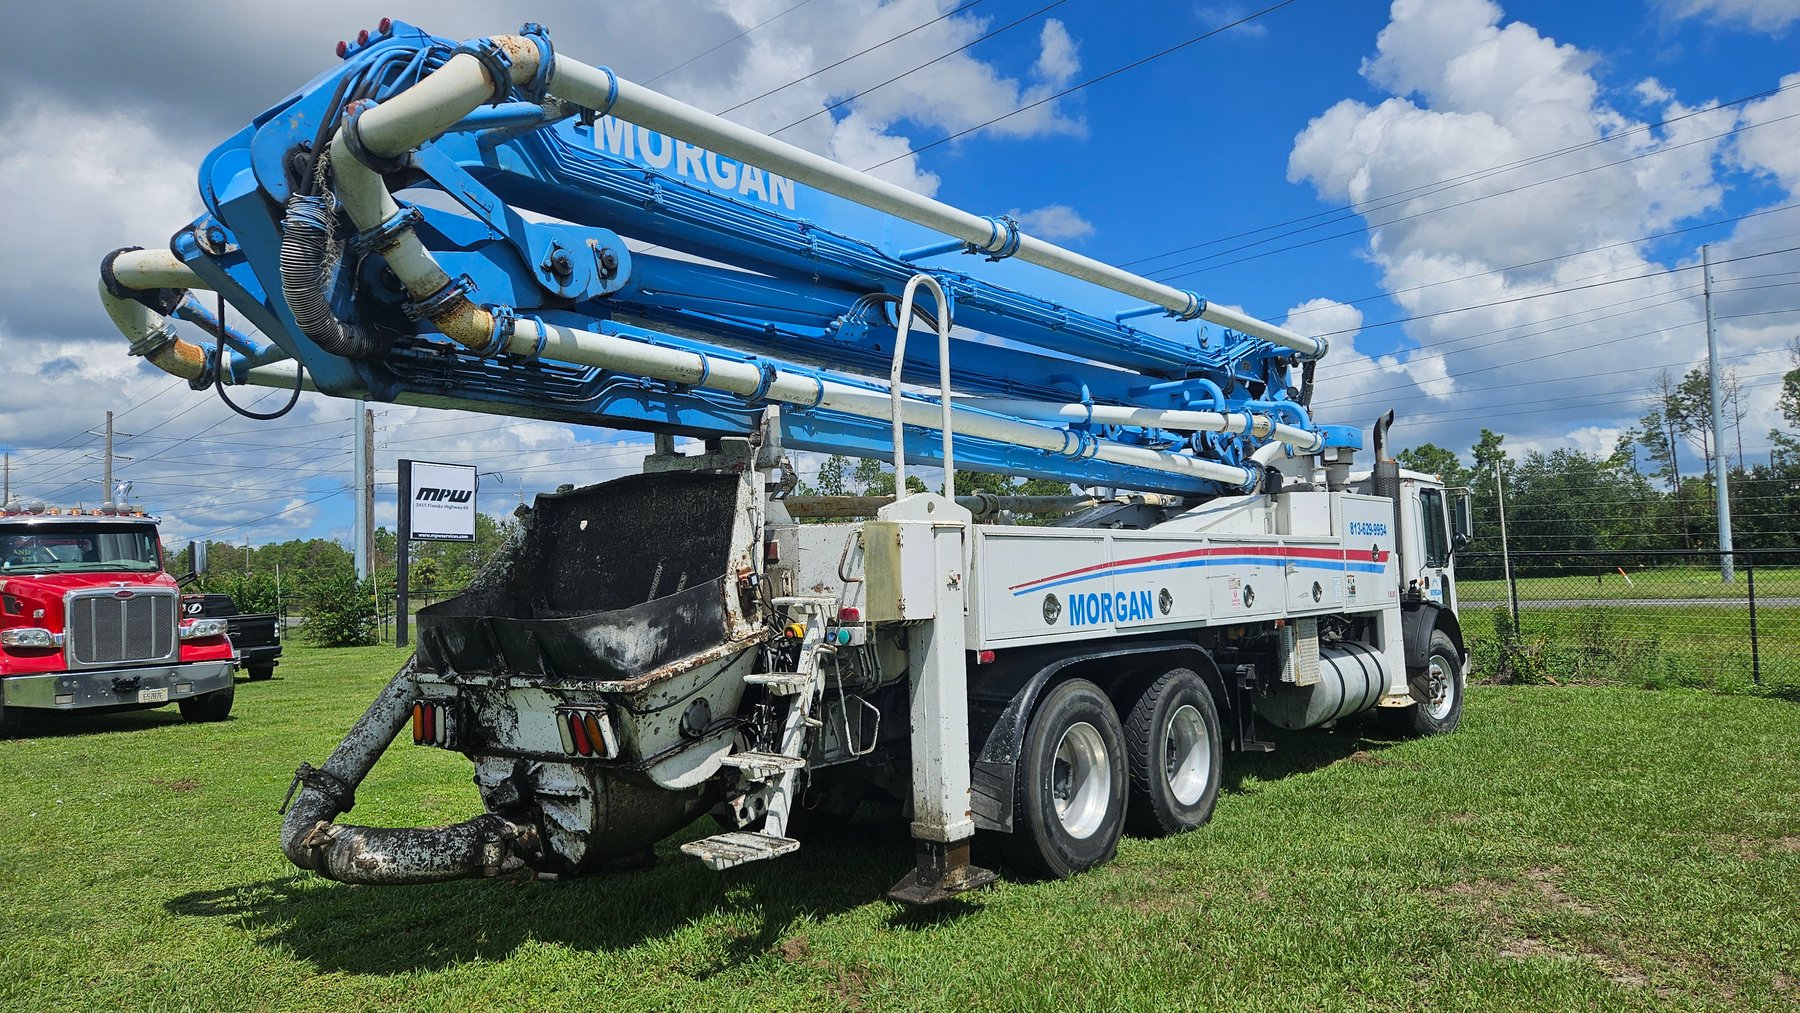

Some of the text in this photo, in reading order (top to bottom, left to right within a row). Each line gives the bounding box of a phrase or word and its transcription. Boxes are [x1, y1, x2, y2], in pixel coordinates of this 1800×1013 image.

[594, 114, 796, 210] MORGAN
[416, 487, 472, 503] MPW
[1350, 521, 1387, 536] 813-629-9954
[1069, 591, 1153, 626] MORGAN
